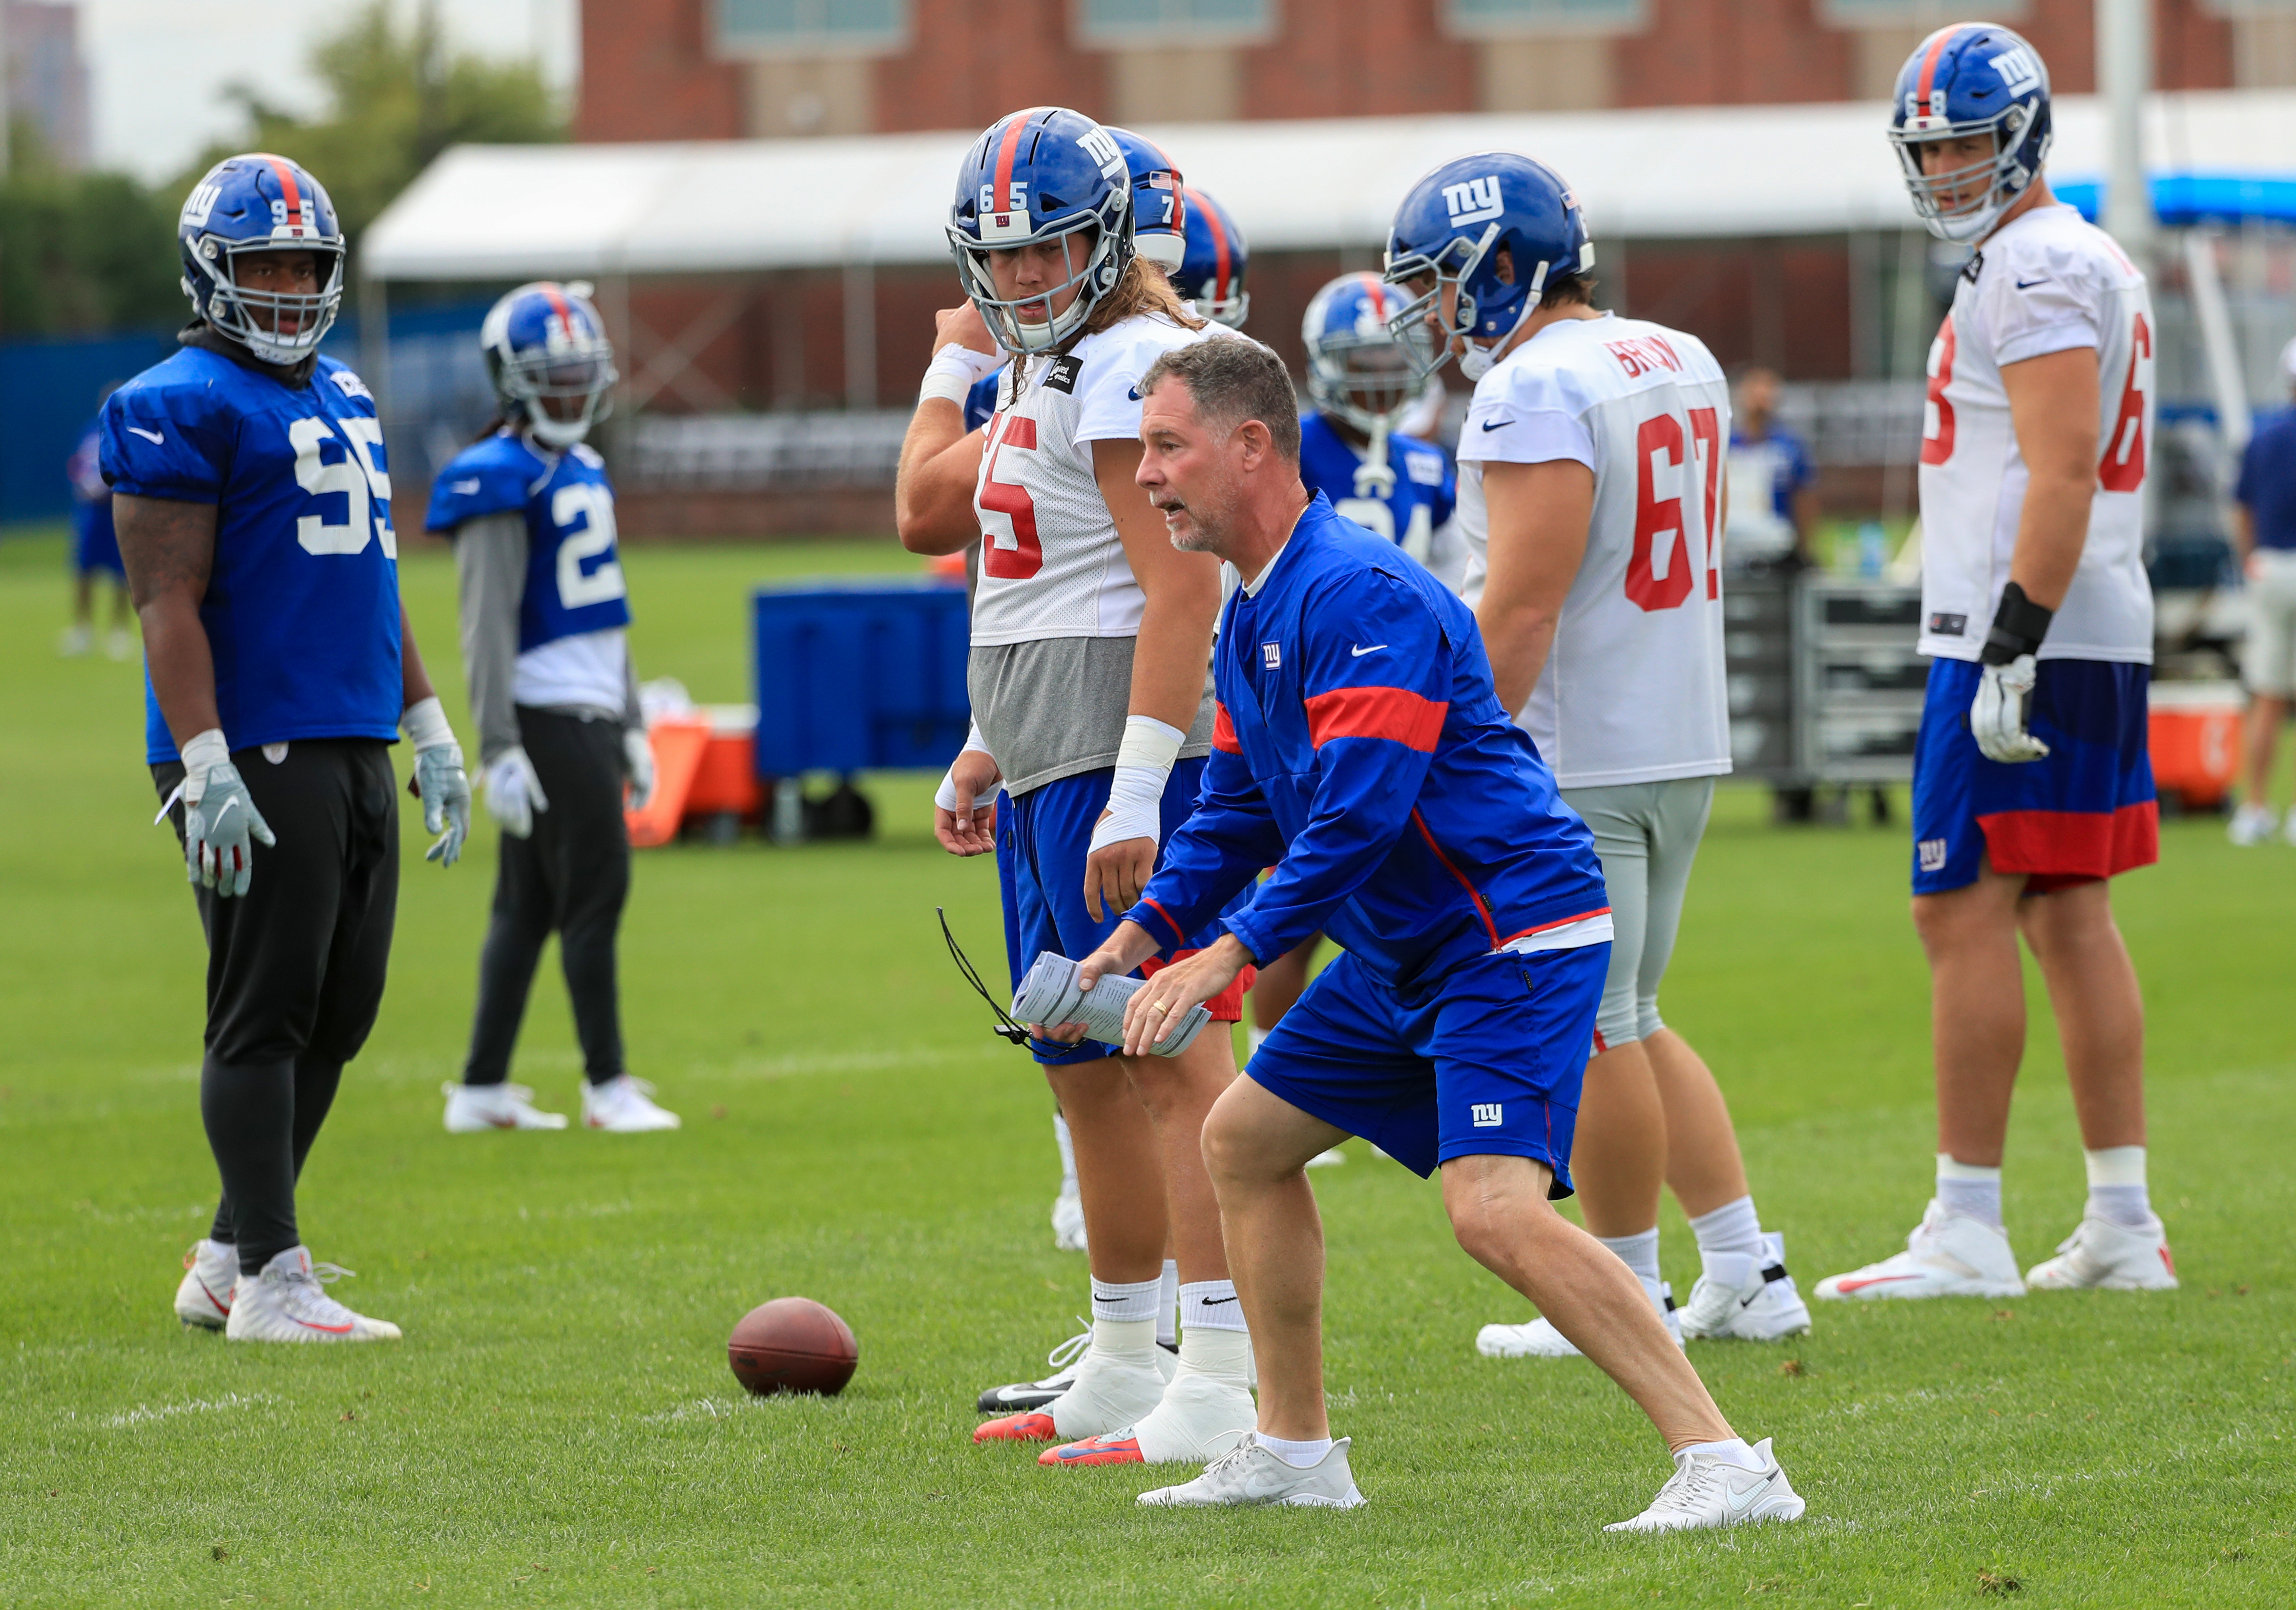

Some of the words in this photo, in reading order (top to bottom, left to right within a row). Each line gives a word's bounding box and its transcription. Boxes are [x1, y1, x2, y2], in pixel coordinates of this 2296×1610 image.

[270, 199, 316, 225] 95
[979, 182, 1029, 212] 65
[1442, 175, 1504, 228] ny
[288, 415, 398, 560] 95
[973, 412, 1043, 579] 5
[1625, 407, 1719, 613] 67
[1262, 643, 1281, 669] ny
[1471, 1103, 1503, 1127] ny
